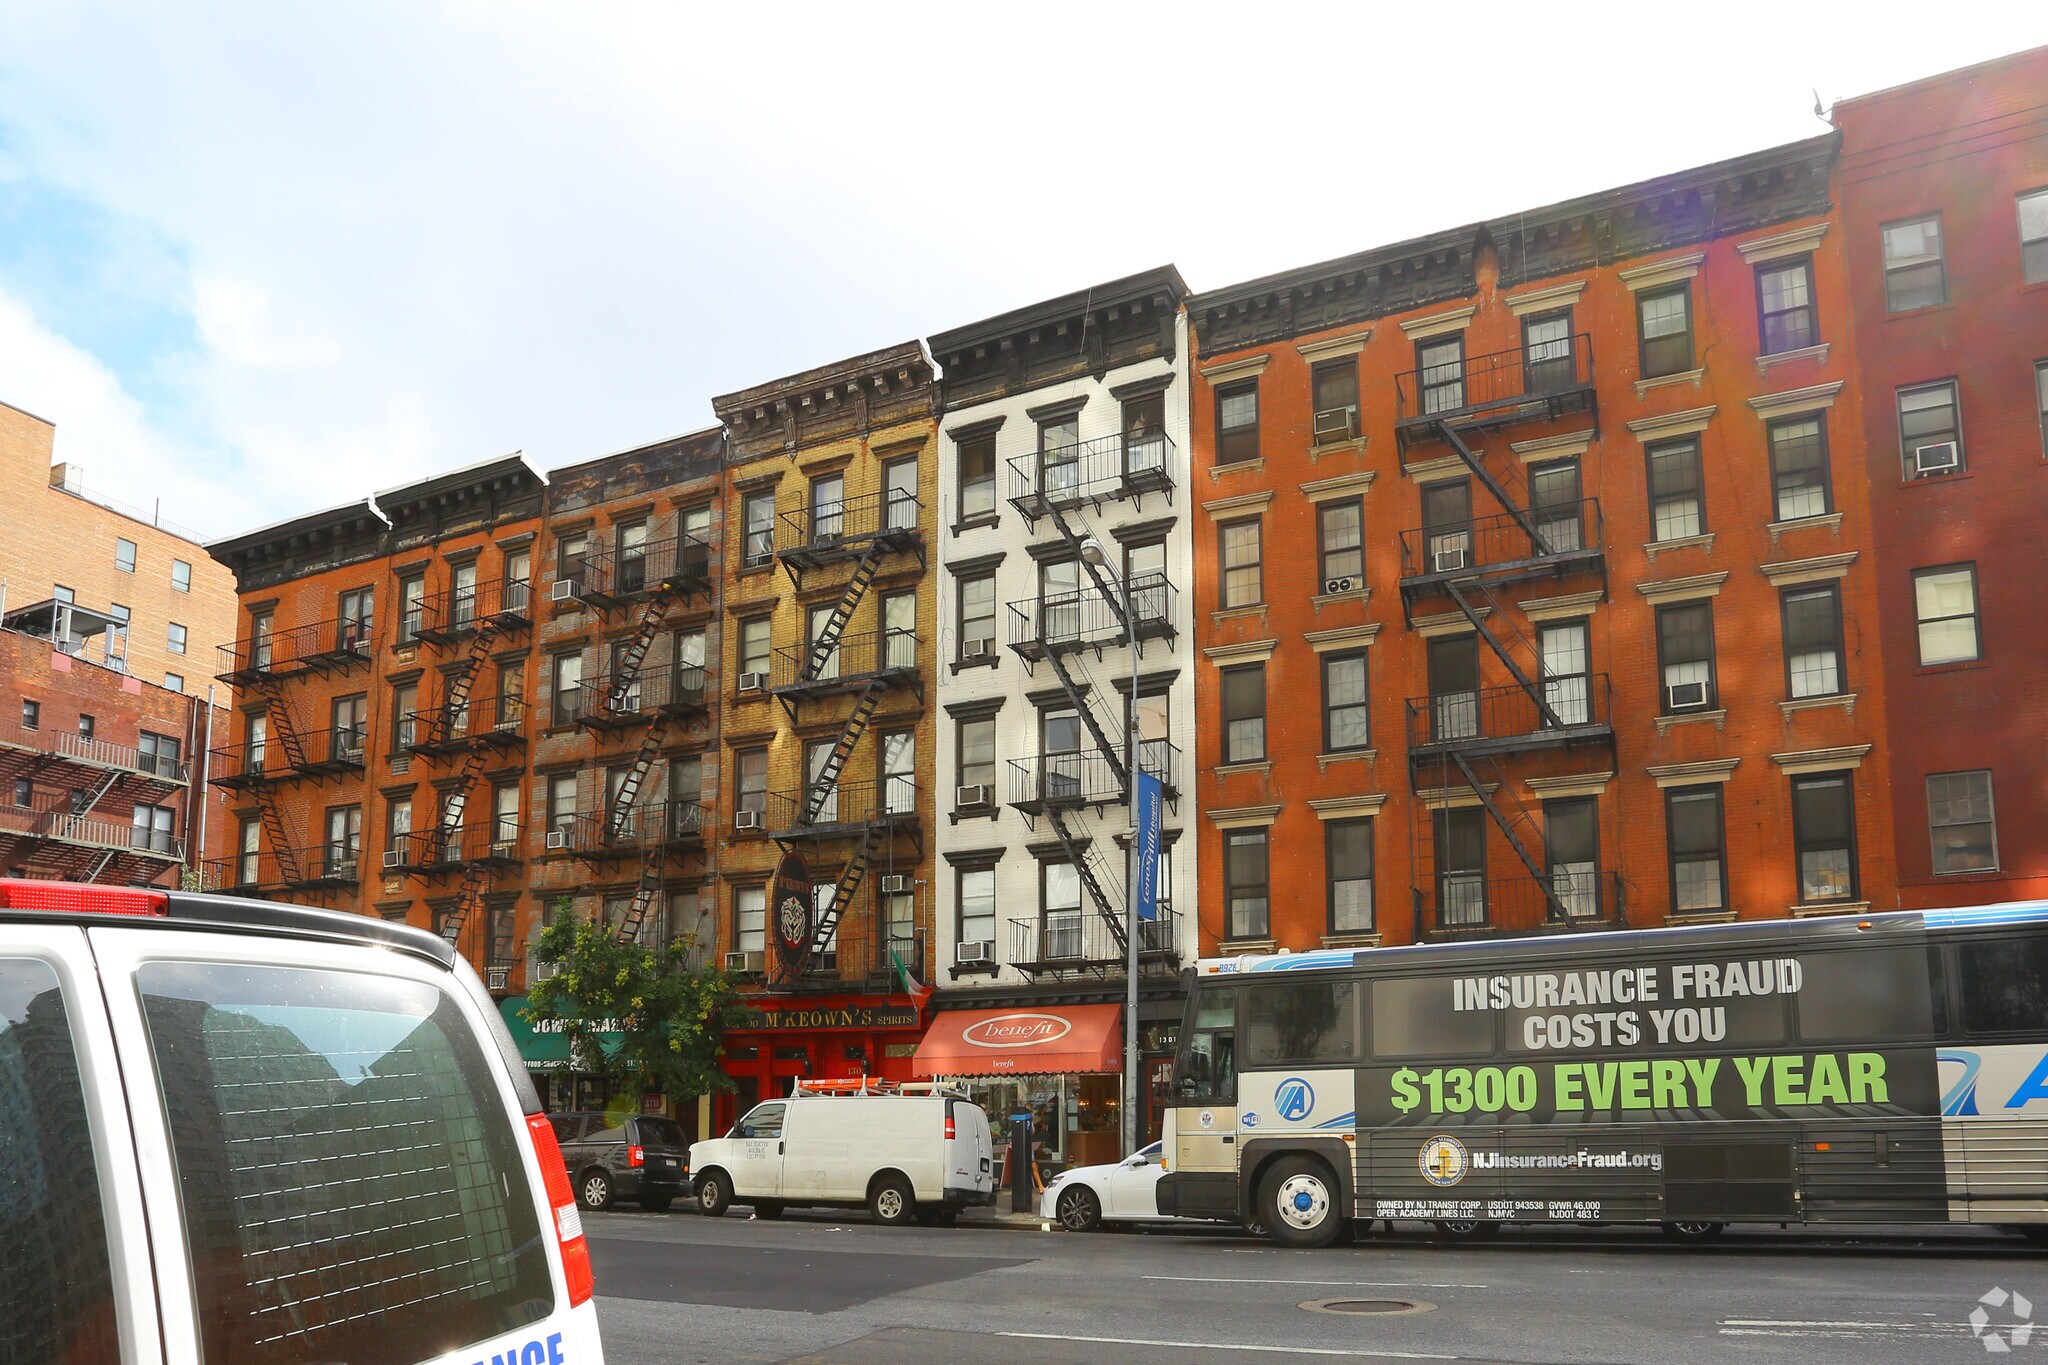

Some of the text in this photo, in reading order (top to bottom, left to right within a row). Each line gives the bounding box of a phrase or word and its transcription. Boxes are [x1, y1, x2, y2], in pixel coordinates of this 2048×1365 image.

[1147, 830, 1155, 862] Hill
[1453, 958, 1804, 1012] INSURANCE FRAUD
[877, 1015, 913, 1025] SPIRITS
[984, 1020, 1055, 1039] benefit
[1523, 1006, 1726, 1050] COSTS YOU
[992, 1059, 1014, 1069] benefit
[1390, 1052, 1890, 1114] $1300 EVERY YEAR
[644, 1099, 659, 1108] ATM
[1376, 1201, 1600, 1210] OWNED BY NJ TRANSIT CORP. USDOT 943538 GVWR 46,000
[1376, 1209, 1398, 1218] OPER.
[1400, 1209, 1435, 1218] ACADEMY
[1437, 1209, 1458, 1218] LINES
[1459, 1210, 1476, 1218] LLC.
[1549, 1210, 1574, 1219] NJDOT
[1576, 1210, 1592, 1218] 483
[1594, 1210, 1600, 1218] C
